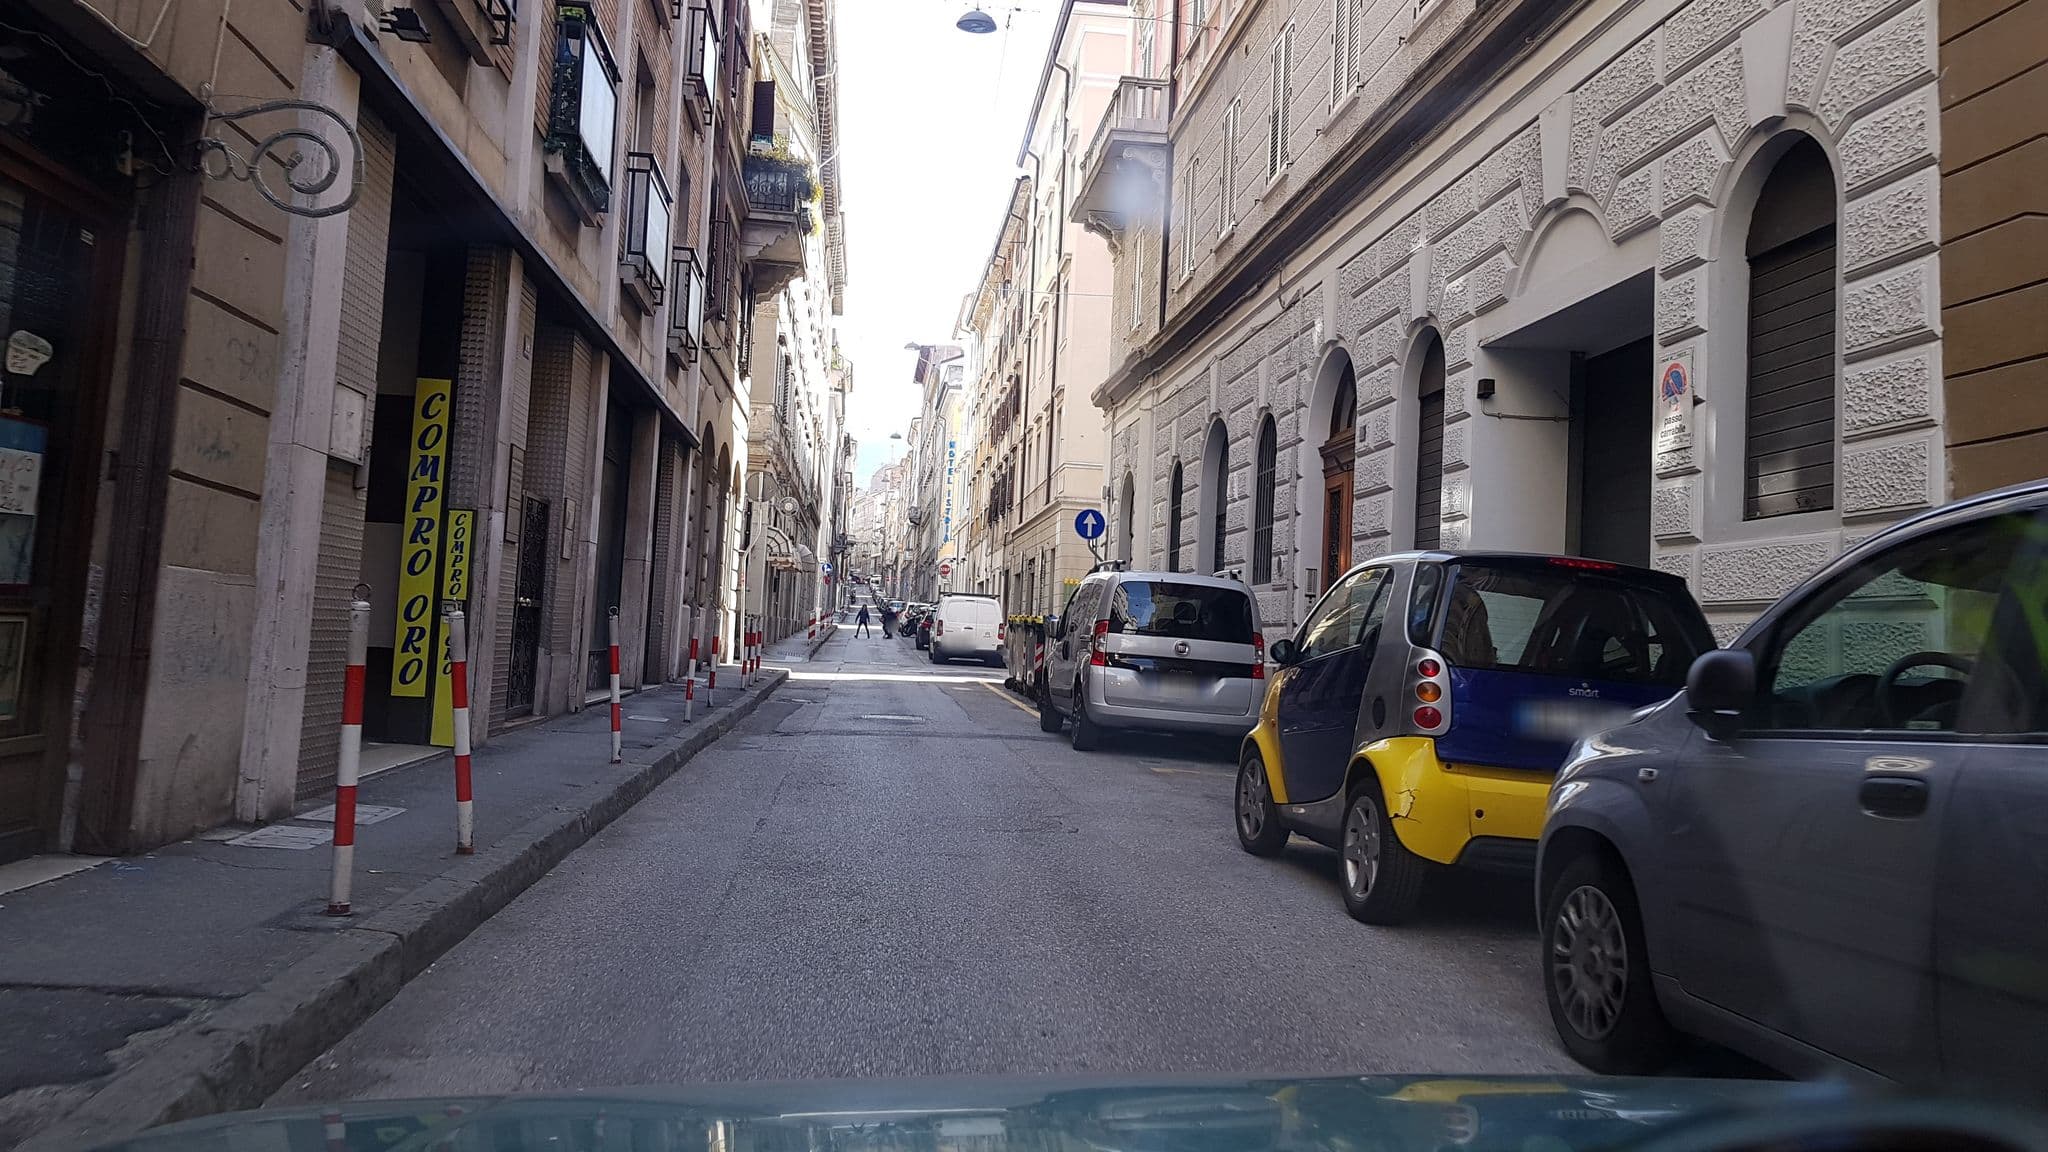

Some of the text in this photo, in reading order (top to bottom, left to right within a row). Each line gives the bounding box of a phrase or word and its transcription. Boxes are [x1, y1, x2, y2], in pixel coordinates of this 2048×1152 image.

[1664, 414, 1683, 428] passo
[947, 441, 956, 485] HOTEL
[399, 392, 447, 686] COMPRO ORO
[449, 513, 467, 596] COMPRO
[1568, 687, 1600, 698] smart
